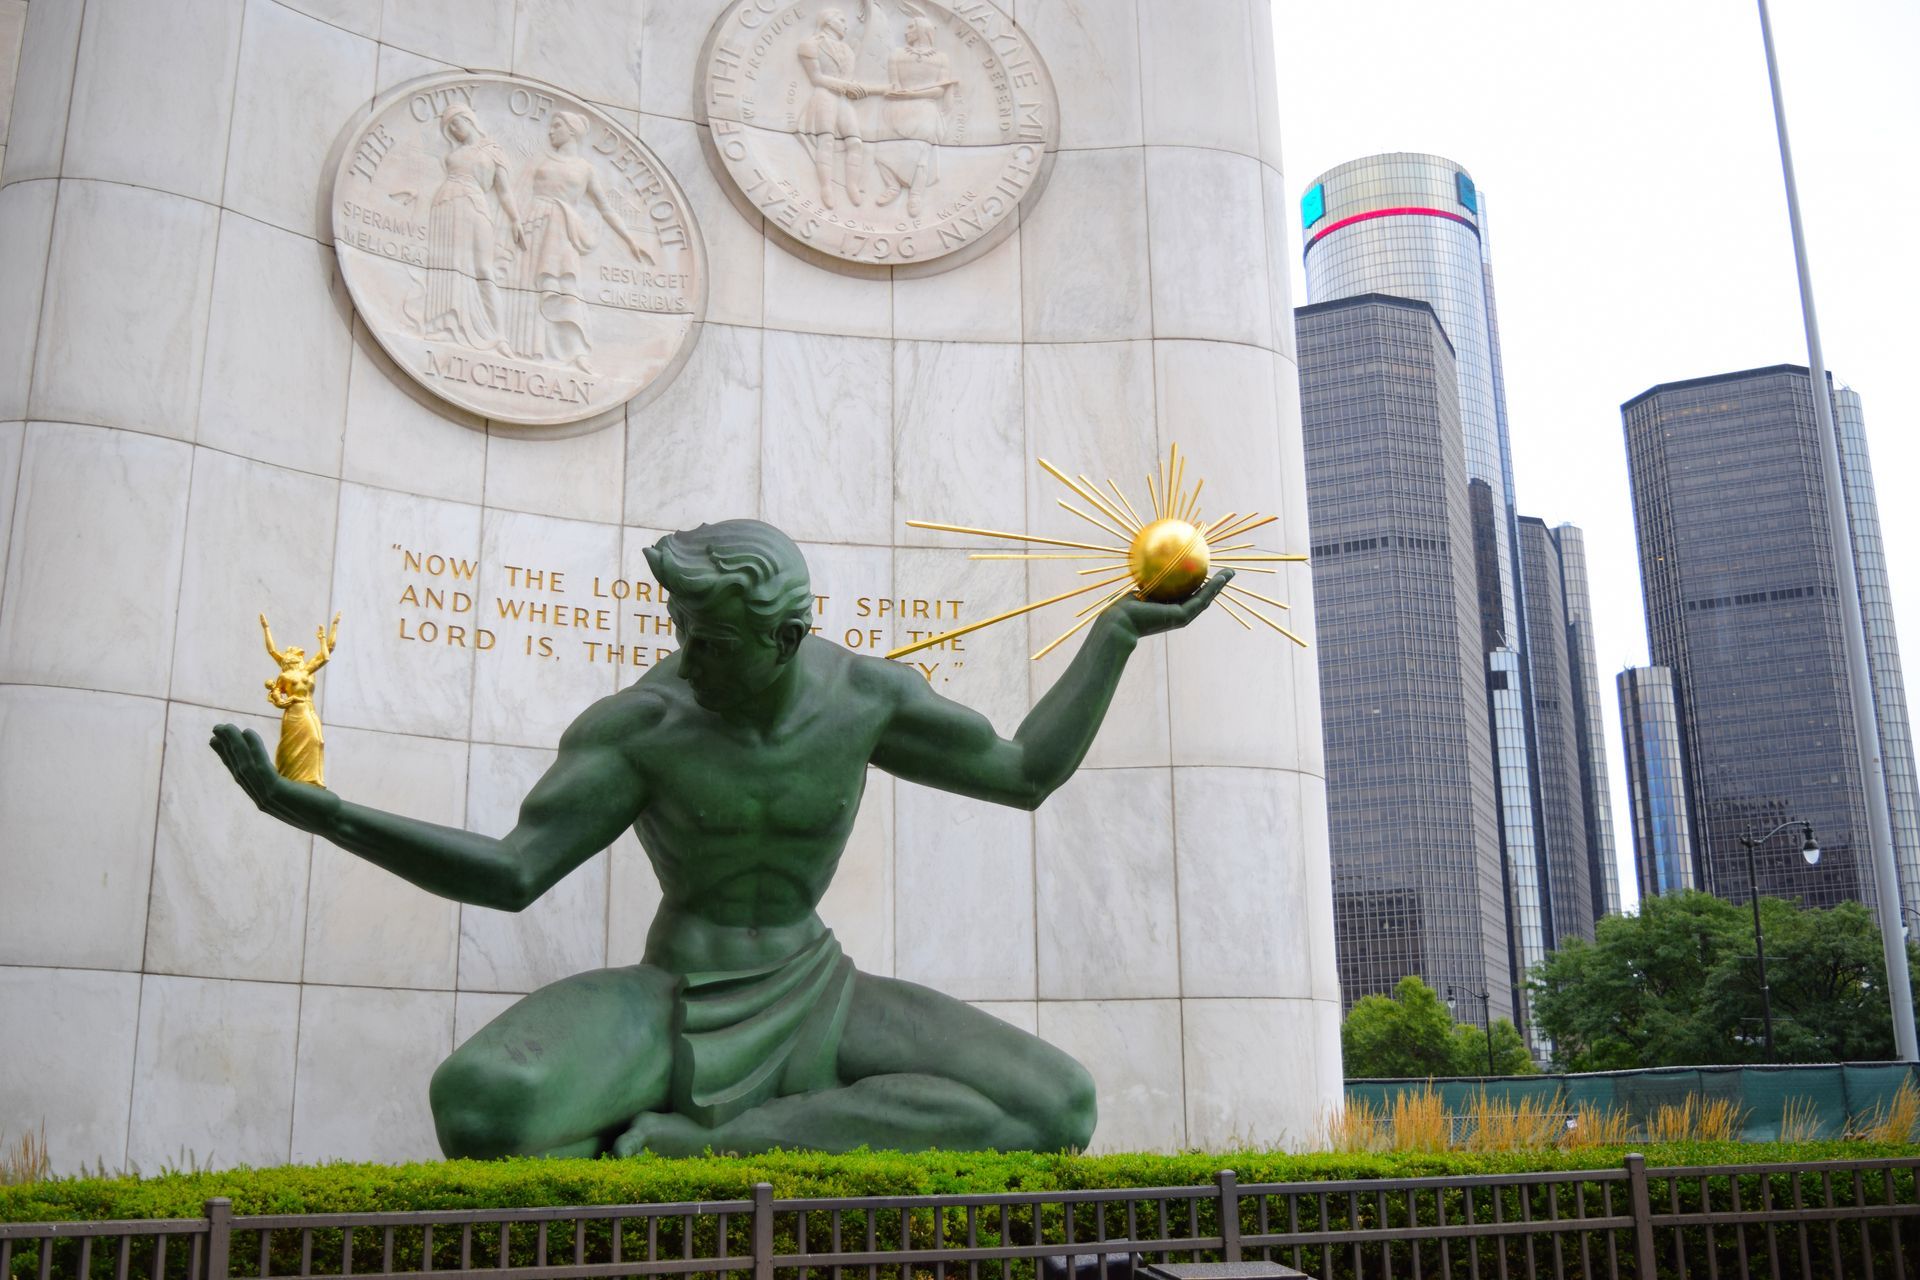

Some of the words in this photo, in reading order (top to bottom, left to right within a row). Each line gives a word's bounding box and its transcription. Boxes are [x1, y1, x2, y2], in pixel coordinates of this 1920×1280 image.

[711, 41, 742, 105] THE
[744, 8, 808, 81] PRODUCE
[954, 29, 980, 49] WE
[982, 58, 1012, 133] DEFEND
[348, 124, 395, 184] THE
[409, 84, 481, 123] CITY
[508, 88, 554, 122] OF
[592, 127, 688, 251] DETROIT
[715, 122, 747, 162] OF
[747, 169, 820, 240] SEAL
[936, 102, 1044, 249] MICHIGAN
[777, 179, 876, 233] FREEDOM
[895, 219, 922, 232] OF
[936, 190, 978, 221] MAN
[839, 232, 915, 259] 1796
[599, 265, 689, 289] RESVRGET
[424, 350, 595, 405] MICHIGAN
[399, 584, 473, 613] AND
[496, 597, 612, 631] WHERE
[844, 628, 884, 650] OF
[504, 565, 566, 594] THE
[856, 596, 965, 620] SPIRIT
[399, 618, 497, 651] LORD
[525, 635, 561, 662] IS,
